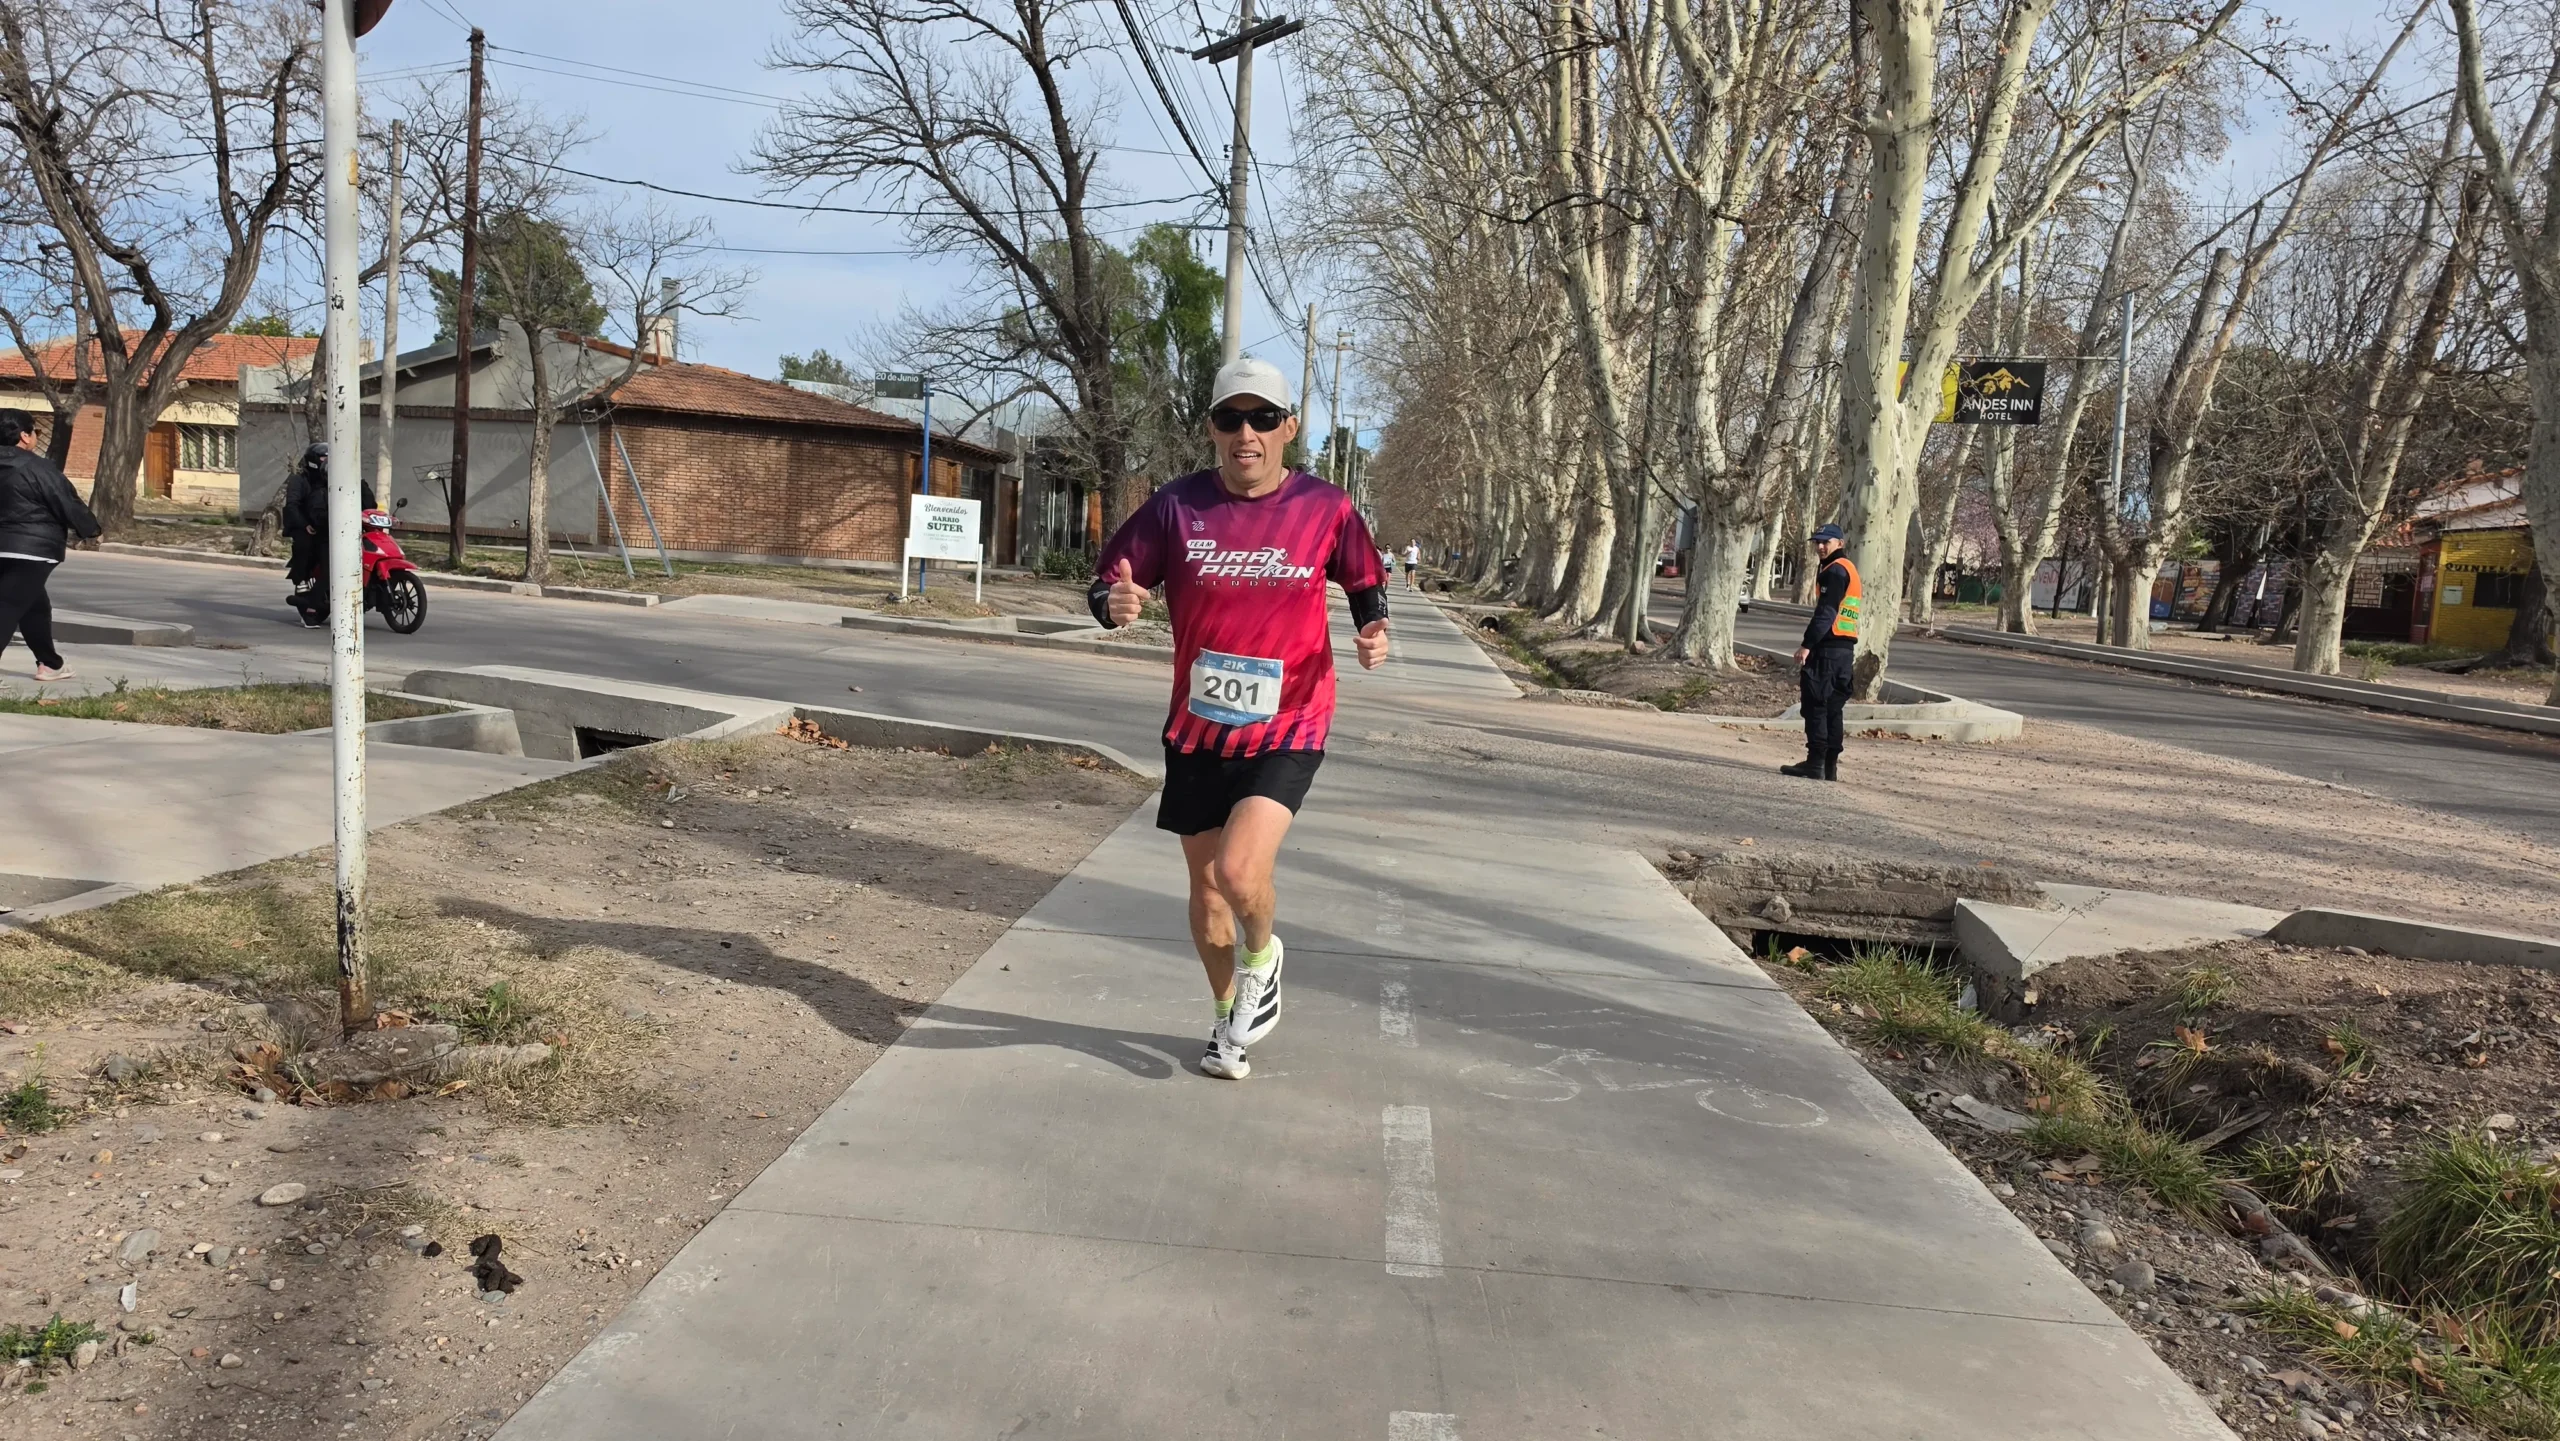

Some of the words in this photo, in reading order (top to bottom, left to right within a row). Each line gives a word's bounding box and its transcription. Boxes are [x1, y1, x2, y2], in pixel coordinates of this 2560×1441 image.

[876, 372, 887, 381] 20
[887, 373, 897, 381] de
[897, 373, 919, 383] Junio
[1963, 398, 2008, 411] ANDES
[2010, 398, 2034, 411] INN
[1980, 412, 2012, 421] HOTEL
[924, 503, 968, 515] Bienvenidos
[932, 515, 960, 523] BARRIO
[927, 522, 964, 533] SUTER
[1188, 540, 1214, 548] TEAM
[1185, 551, 1272, 563] PURA
[1196, 580, 1310, 588] MENDOZA
[1222, 659, 1247, 671] 21K
[1203, 675, 1259, 706] 201
